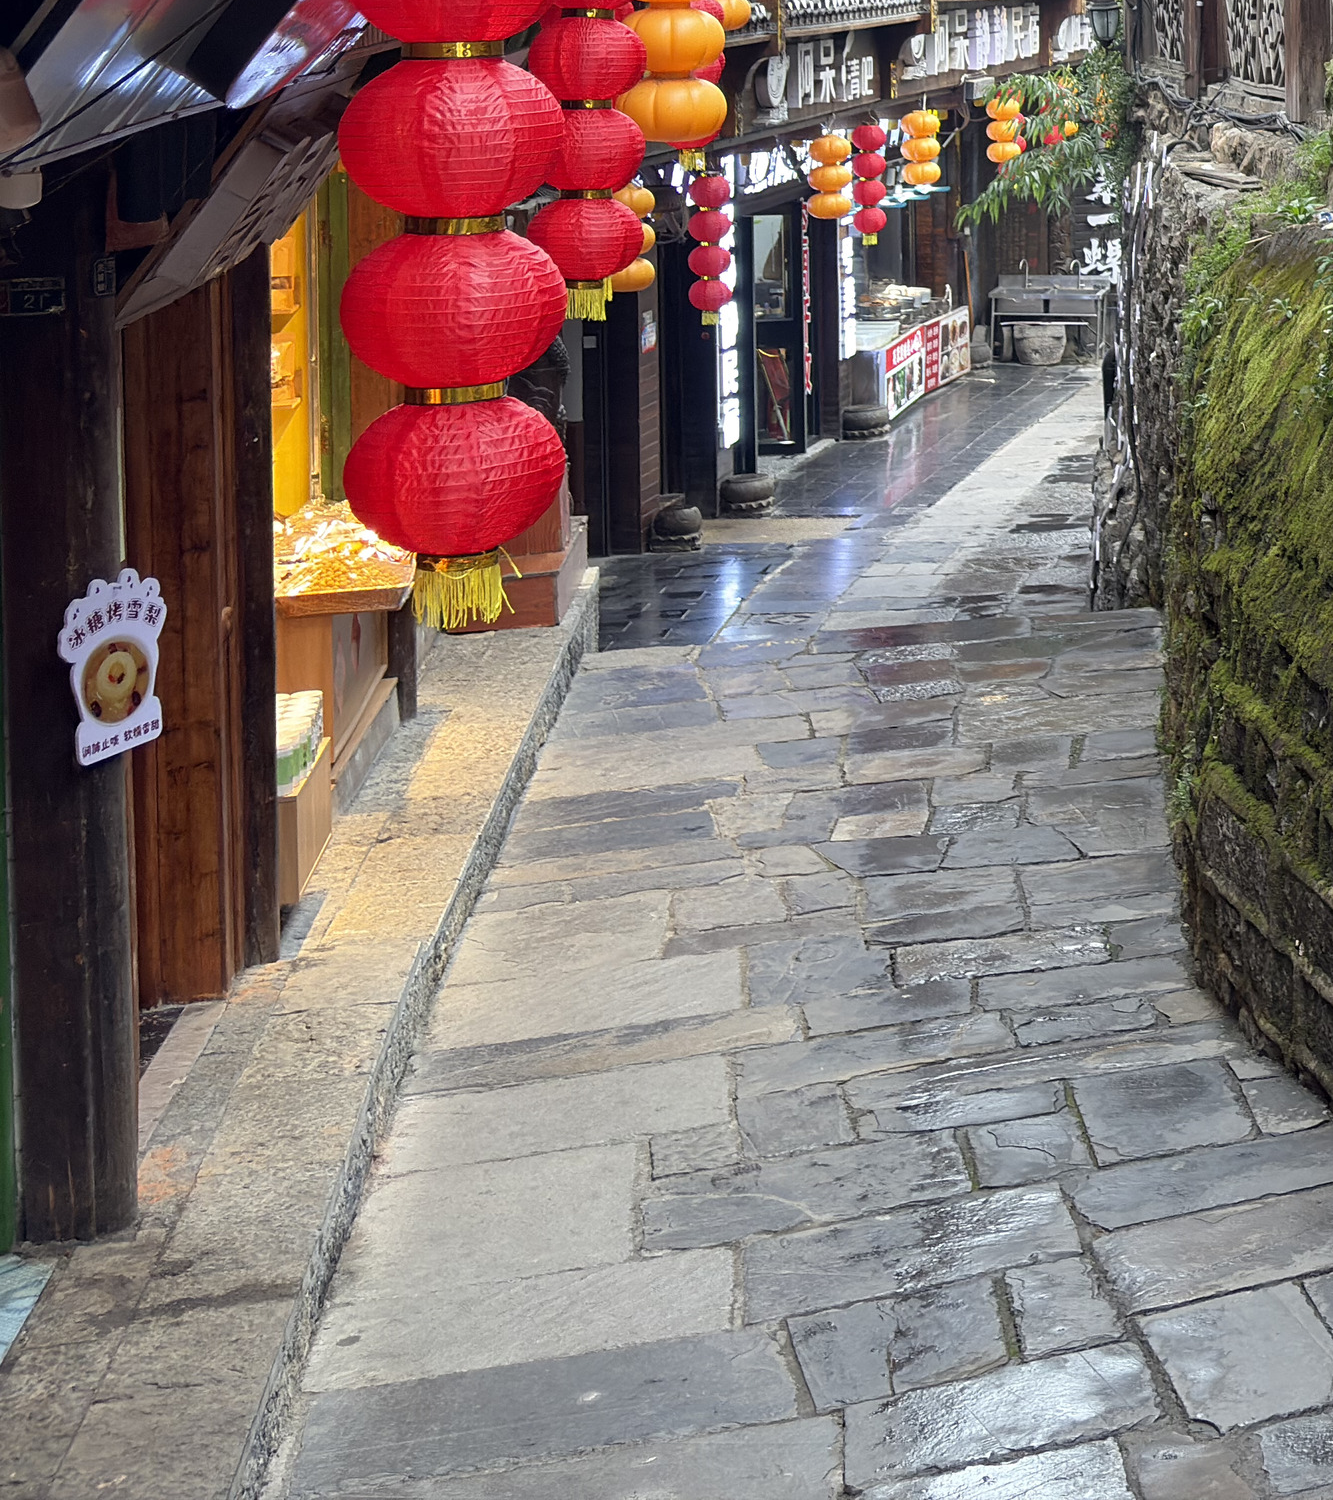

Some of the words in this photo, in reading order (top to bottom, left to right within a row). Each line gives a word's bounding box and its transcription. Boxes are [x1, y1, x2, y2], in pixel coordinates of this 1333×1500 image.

[68, 599, 162, 649] 冰糖烤雪梨
